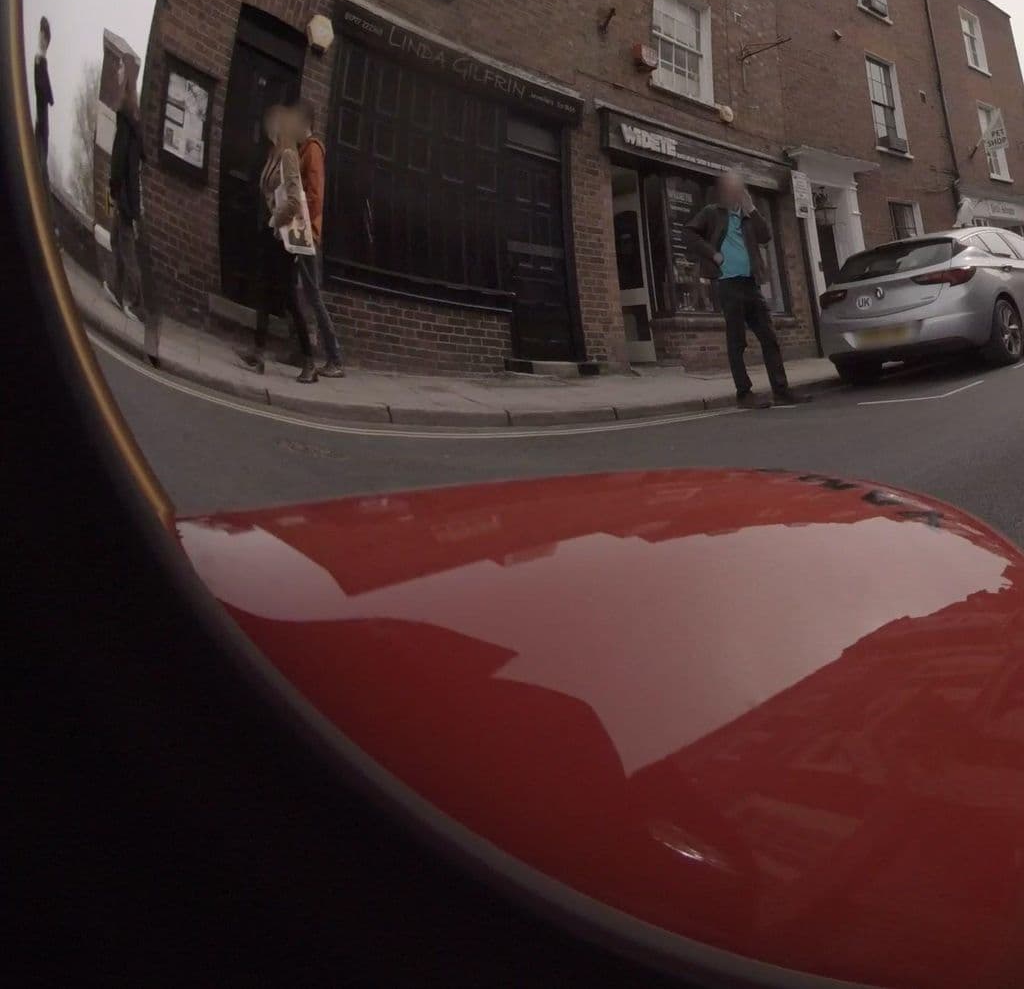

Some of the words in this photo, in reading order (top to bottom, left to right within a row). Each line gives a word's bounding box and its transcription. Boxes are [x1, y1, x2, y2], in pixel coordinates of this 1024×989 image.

[389, 25, 446, 68] LINDA
[452, 56, 526, 99] GILFRIN
[991, 128, 1005, 137] PET
[987, 136, 1007, 148] SHOP
[857, 297, 870, 308] UK
